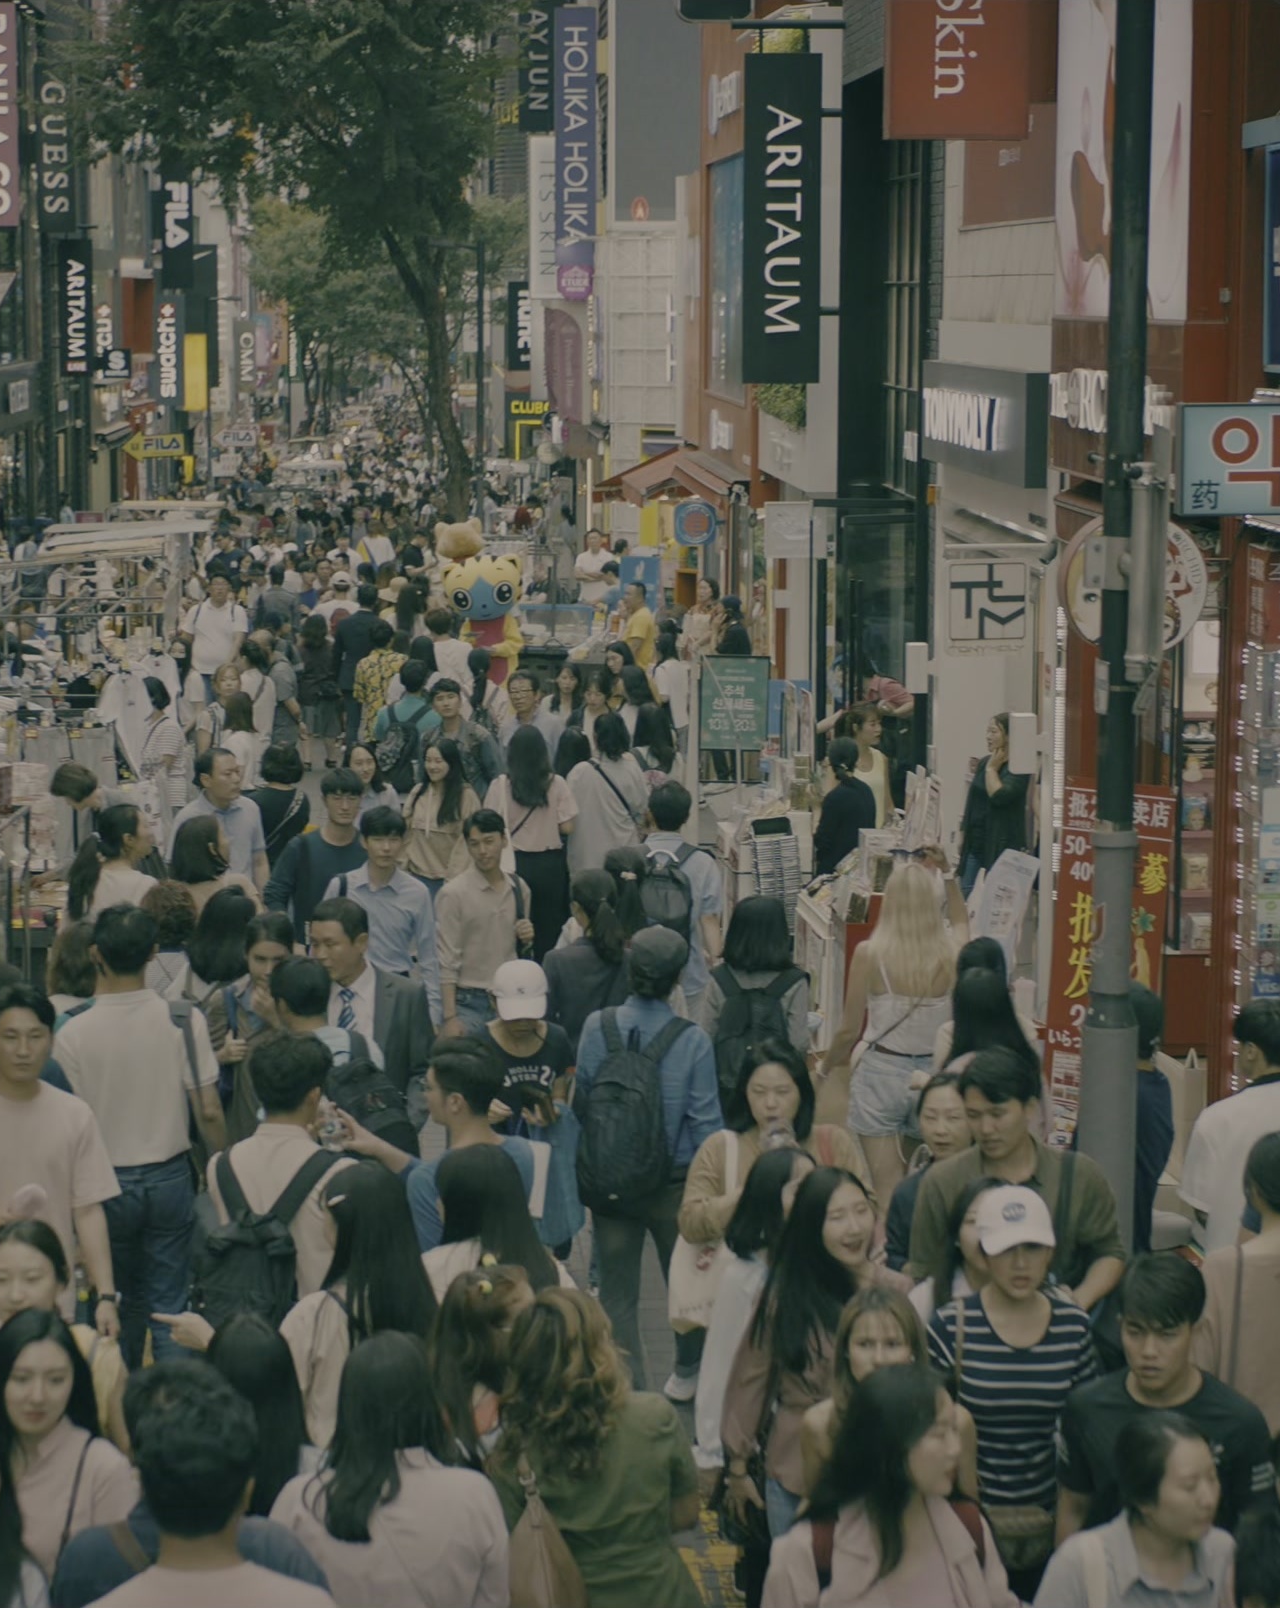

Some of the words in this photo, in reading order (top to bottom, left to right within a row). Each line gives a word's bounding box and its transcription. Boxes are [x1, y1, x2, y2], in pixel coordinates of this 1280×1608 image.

[562, 26, 589, 133] HOLIKA
[40, 80, 70, 214] GUESS
[561, 142, 589, 248] HOLIKA
[164, 181, 190, 249] FILA
[764, 104, 803, 334] ARITAUM
[66, 259, 87, 358] ARITAUM
[143, 437, 181, 451] FILA
[1190, 480, 1221, 511] 药
